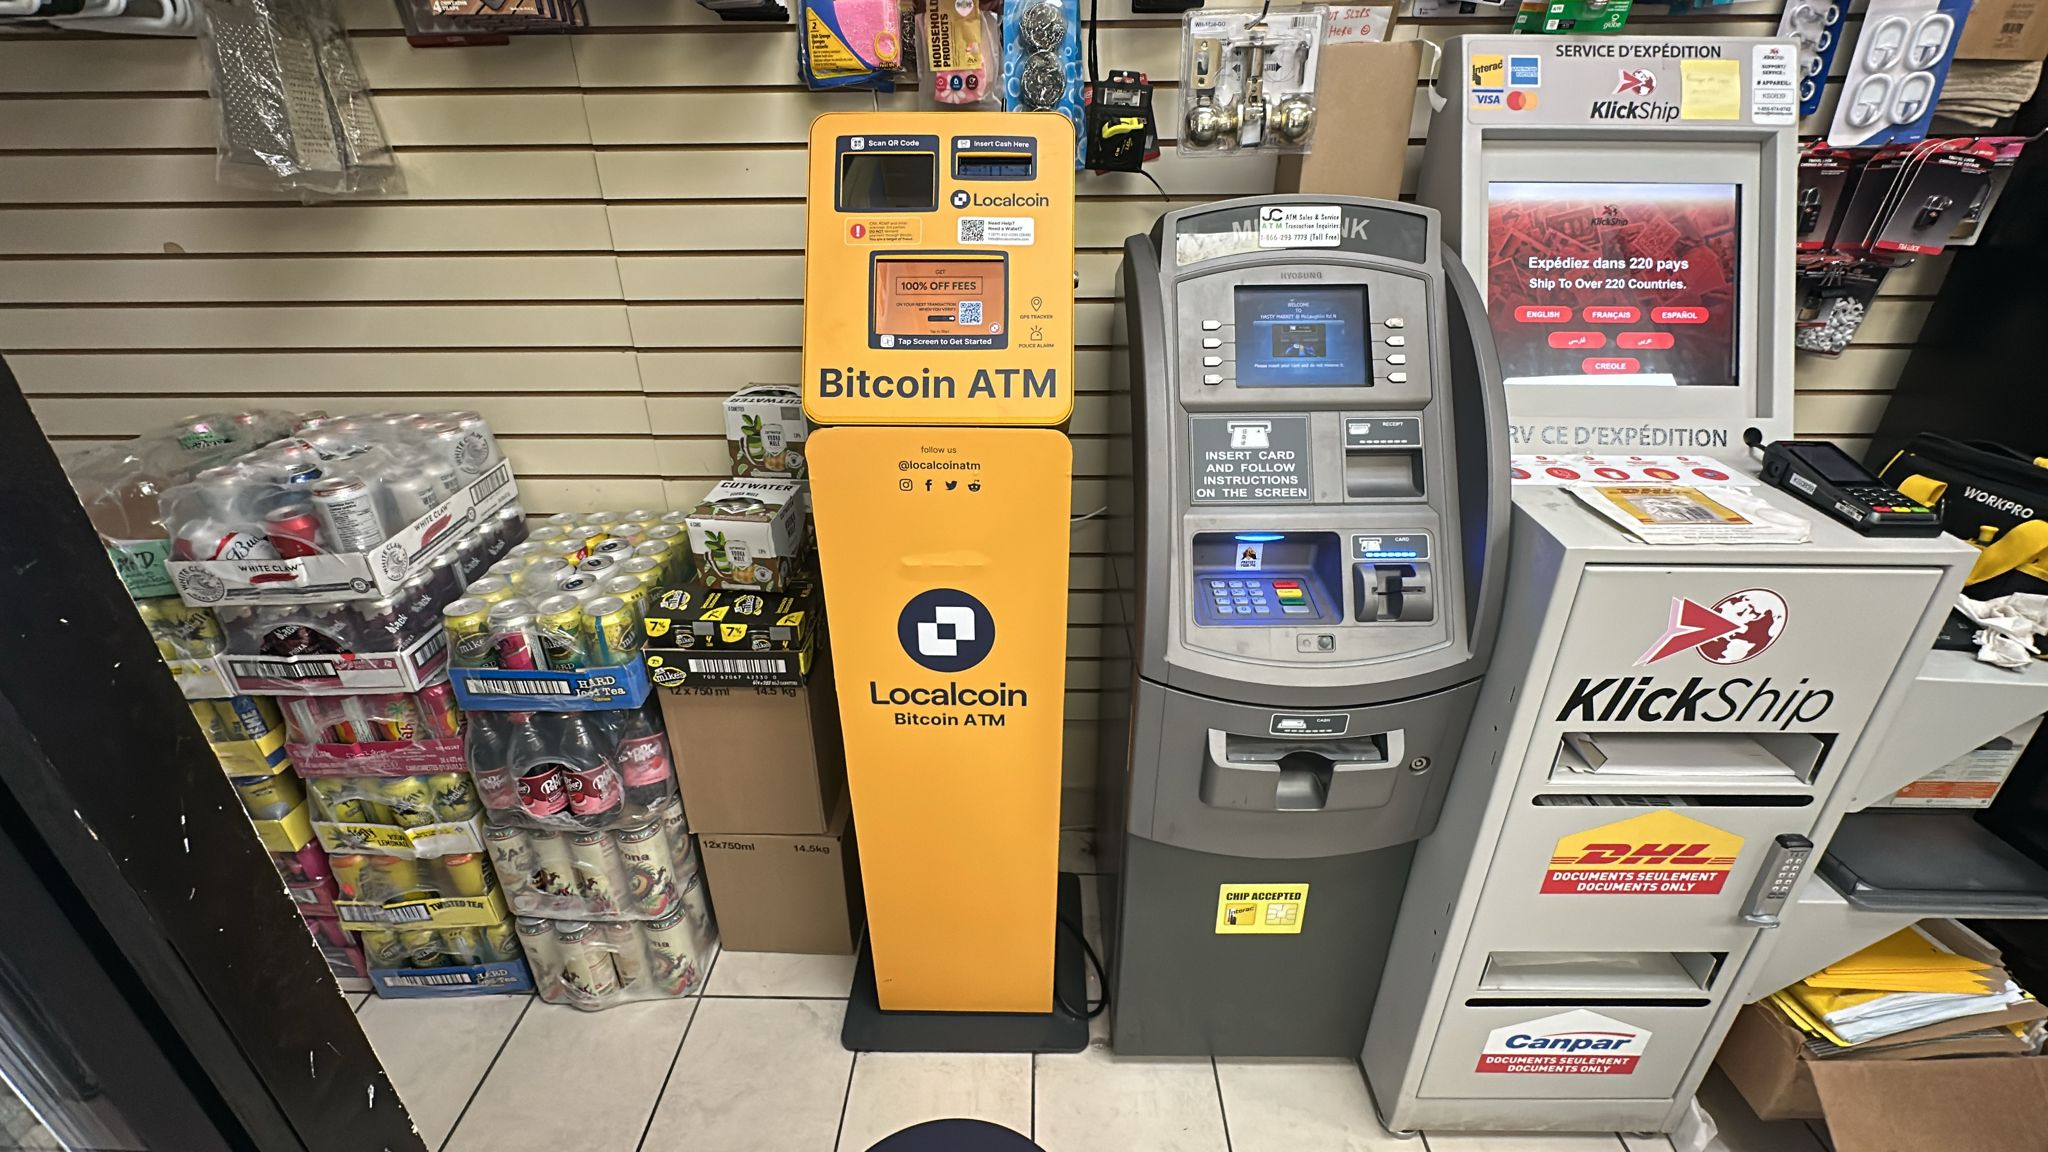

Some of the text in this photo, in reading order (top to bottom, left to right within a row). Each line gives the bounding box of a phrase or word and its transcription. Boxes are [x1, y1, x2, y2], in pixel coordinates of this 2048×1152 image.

[1603, 21, 1622, 30] globe
[929, 0, 942, 68] HOUSEHOLD
[940, 13, 951, 68] PRODUCTS
[1556, 43, 1722, 59] SERVICE D'EXPÉDITION
[1472, 60, 1503, 75] Interac
[1476, 95, 1501, 104] VISA
[1590, 101, 1680, 123] KlickShip
[973, 140, 994, 148] Insert
[995, 140, 1012, 148] Cash
[974, 193, 1049, 207] Localcoin
[1591, 217, 1628, 227] KlickShip
[1309, 233, 1323, 241] (Toll
[1325, 233, 1340, 241] Free)
[1528, 257, 1690, 272] Expédiez dans 220 pays
[901, 281, 976, 291] 100% OFF FEES
[1529, 278, 1687, 291] Ship To Over 220 Countries.
[1526, 310, 1561, 319] ENGLISH
[1591, 311, 1632, 321] FRANÇAIS
[1661, 310, 1699, 320] ESPAÑOL
[898, 338, 911, 346] Tap
[1594, 362, 1627, 371] CREOLE
[819, 368, 1057, 399] Bitcoin ATM
[1574, 422, 1728, 447] D'EXPÉDITION
[921, 445, 944, 454] follow
[1205, 450, 1295, 460] INSERT CARD
[898, 460, 981, 472] @localcoinatm
[1206, 463, 1296, 473] AND FOLLOW
[1203, 475, 1298, 485] INSTRUCTIONS
[720, 482, 794, 492] CUTWATER
[1196, 487, 1307, 498] ON THE SCREEN
[1963, 485, 2035, 520] WORKPRO
[413, 504, 451, 531] WHITE CLAW
[238, 564, 298, 573] WHITE CLAW
[384, 613, 409, 634] black
[274, 624, 299, 641] black
[578, 676, 616, 688] HARD
[603, 687, 626, 696] Tea
[670, 687, 681, 695] 12
[692, 687, 713, 697] 750
[715, 687, 730, 696] ml
[755, 687, 797, 698] 14.5 kg
[869, 681, 1028, 707] Localcoin
[1556, 677, 1834, 731] KlickShip
[894, 712, 1006, 726] Bitcoin ATM
[703, 839, 755, 851] 12x750ml
[793, 843, 831, 854] 14.5kg
[1576, 843, 1712, 865] DHL
[1553, 872, 1719, 883] DOCUMENTS SEULEMENT
[1577, 882, 1695, 892] DOCUMENTS ONLY
[1226, 892, 1302, 900] CHIP ACCEPTED
[429, 900, 484, 912] TWISTED TEA
[1506, 1033, 1633, 1054] Canpar
[1485, 1056, 1630, 1065] DOCUMENTS SEULEMENT
[1506, 1065, 1611, 1073] DOCUMENTS ONLY
